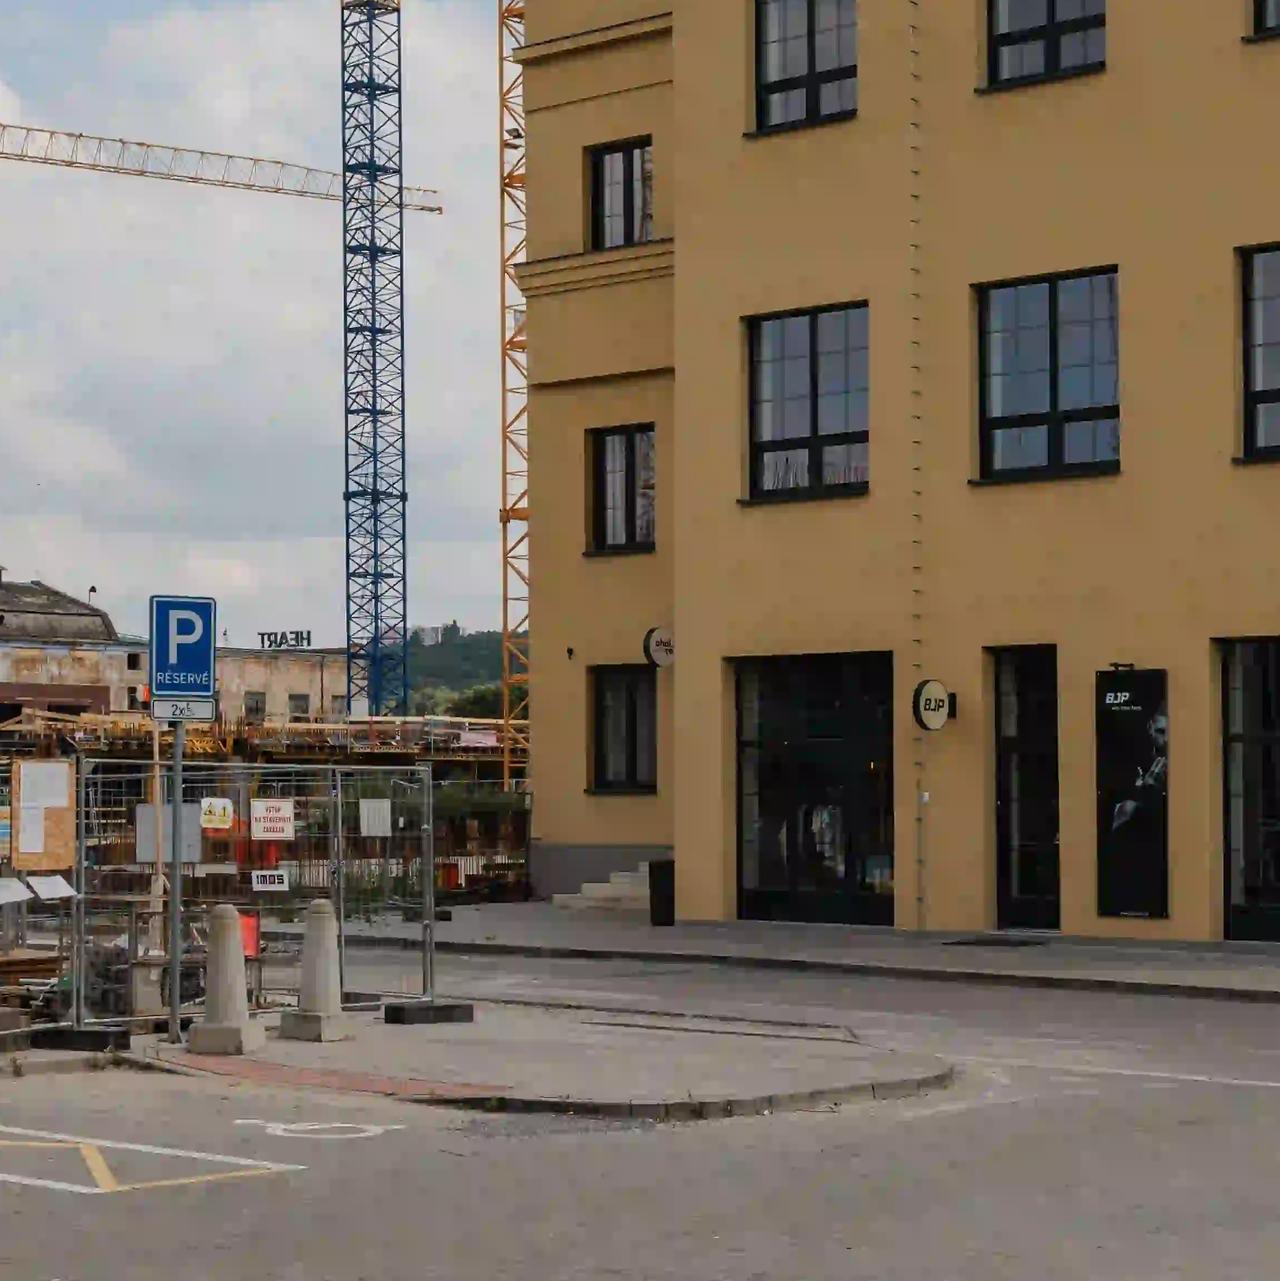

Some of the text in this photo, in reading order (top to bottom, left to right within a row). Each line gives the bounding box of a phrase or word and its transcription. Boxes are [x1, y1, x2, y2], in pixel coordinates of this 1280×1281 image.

[168, 609, 204, 665] P
[923, 698, 945, 712] BJP
[1105, 692, 1130, 704] BJP
